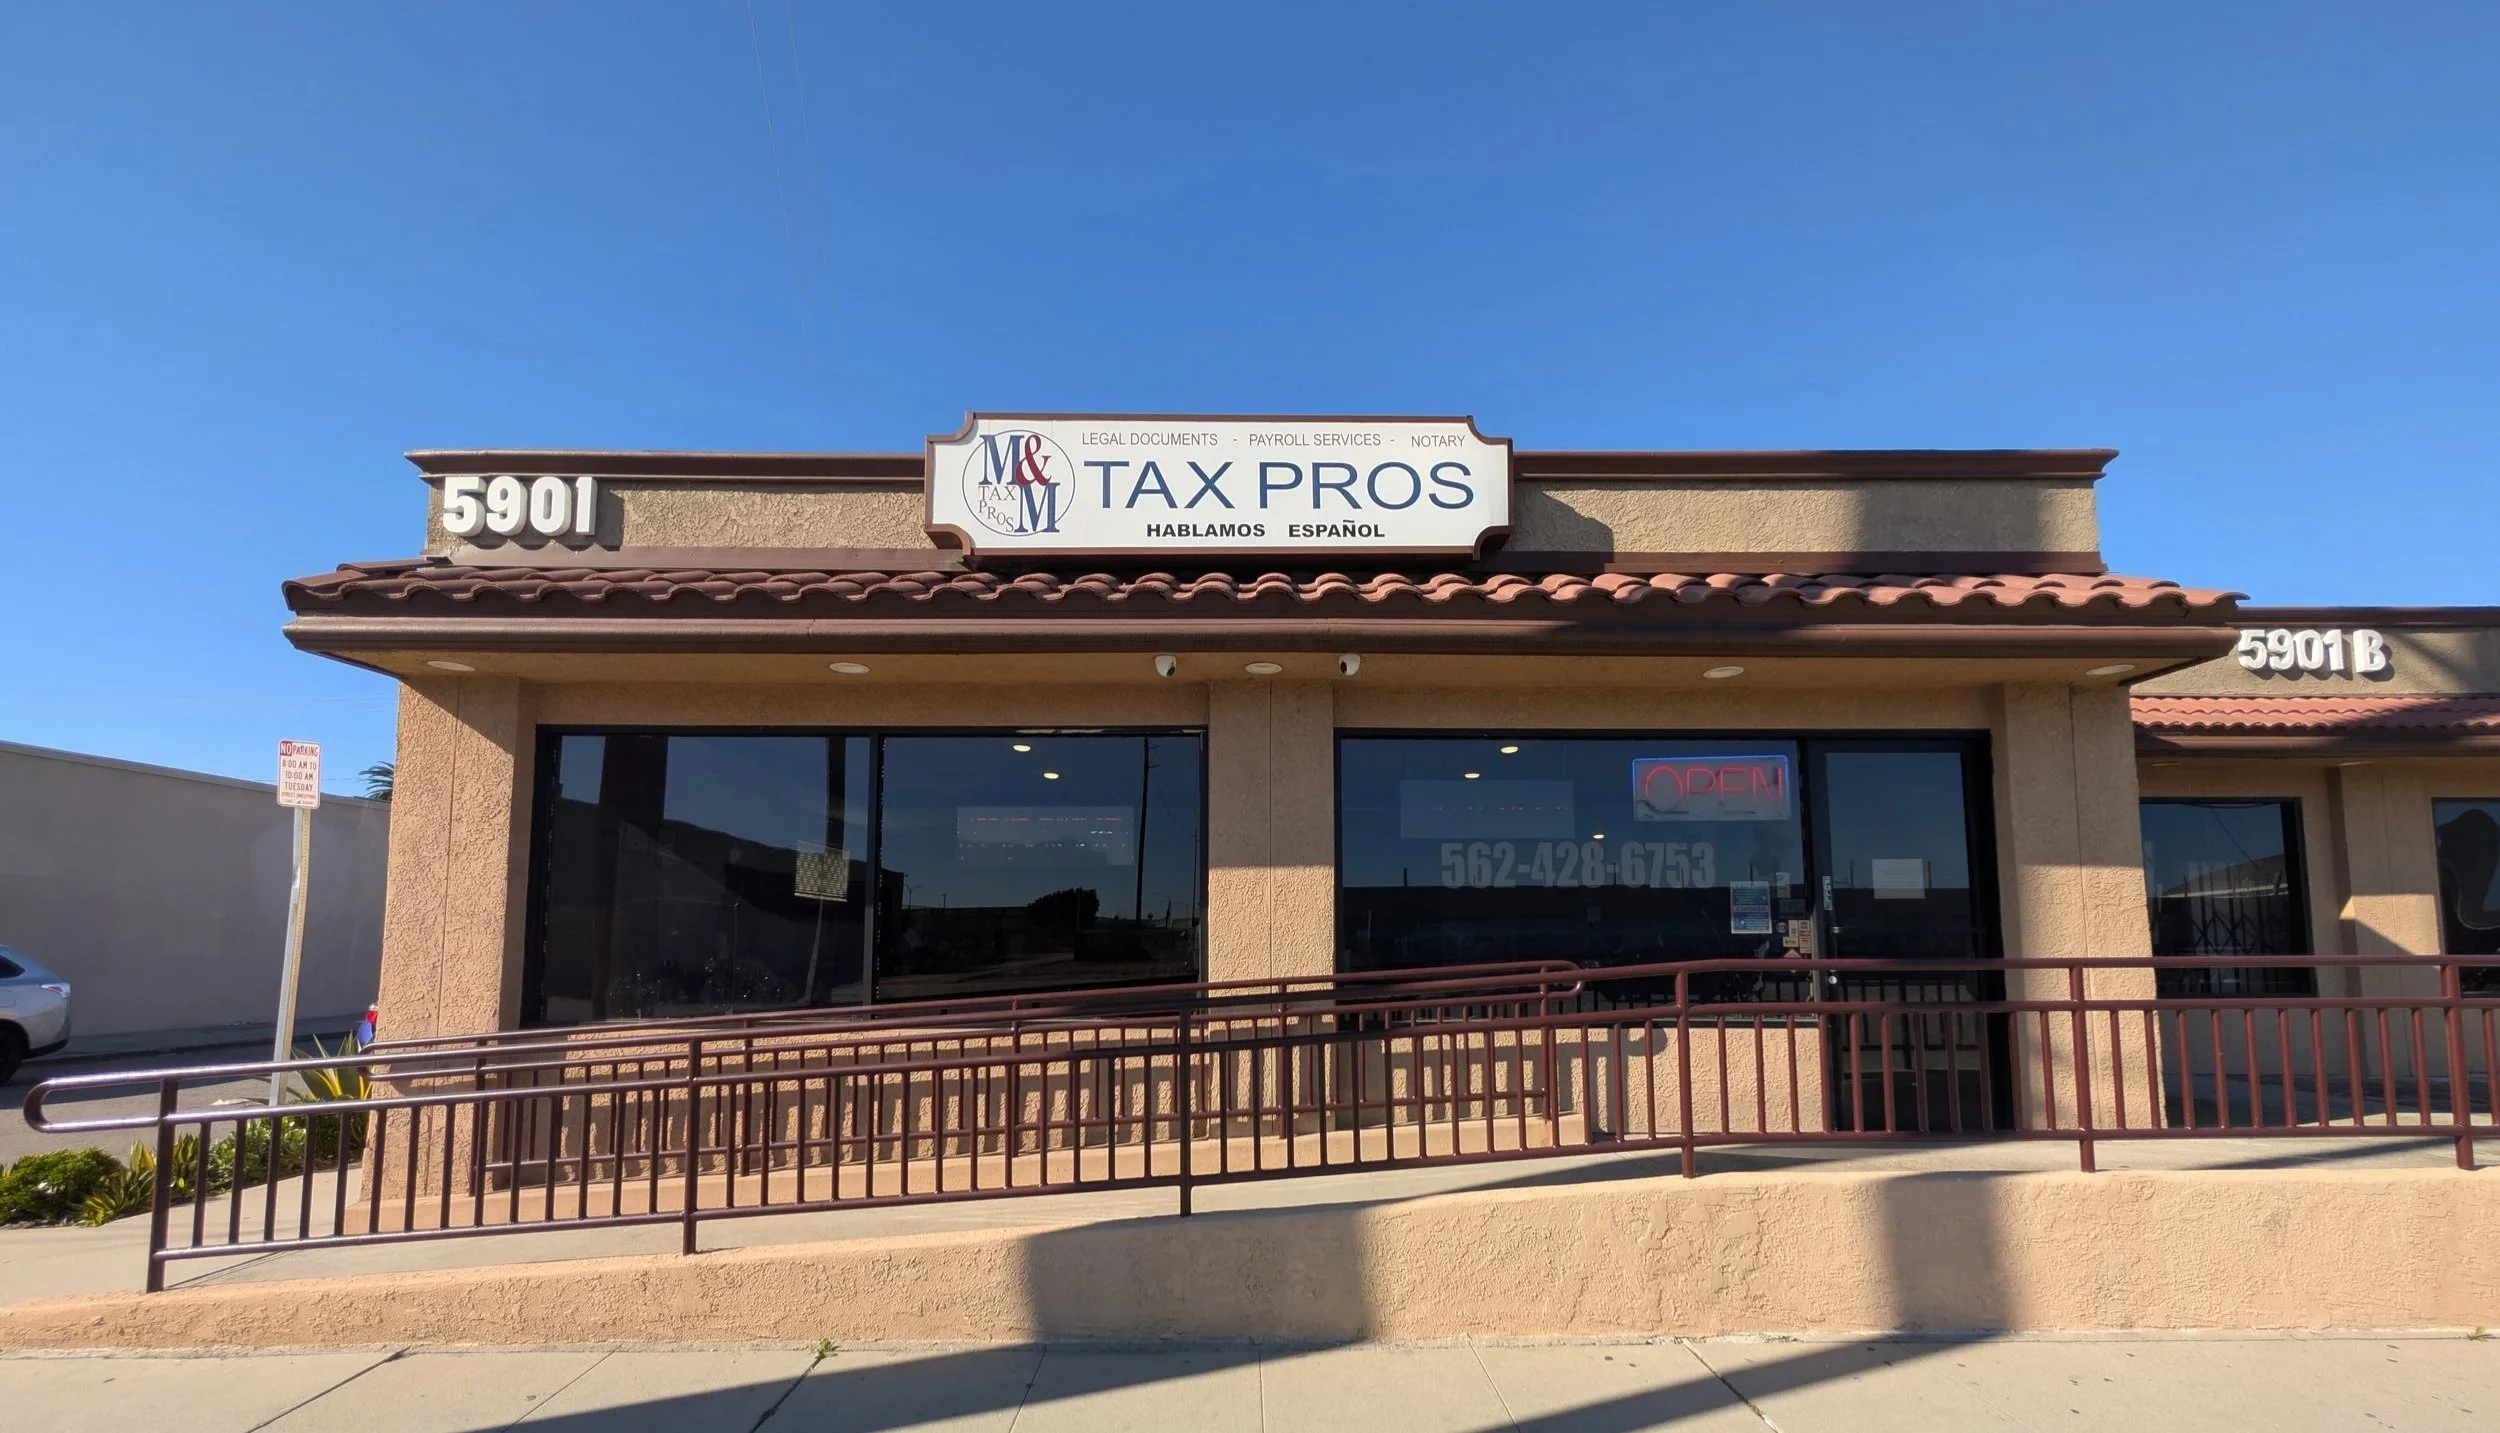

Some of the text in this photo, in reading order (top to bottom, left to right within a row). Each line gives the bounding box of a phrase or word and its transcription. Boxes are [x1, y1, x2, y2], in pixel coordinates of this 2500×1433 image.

[1081, 432, 1126, 446] LEGAL
[1130, 432, 1218, 446] DOCUMENTS
[1249, 433, 1309, 446] PAYROLL
[1313, 433, 1381, 446] SERVICES
[1411, 435, 1466, 447] NOTARY
[977, 485, 1017, 501] TAX
[1083, 460, 1474, 510] TAX PROS
[442, 475, 598, 537] 5901
[977, 500, 1014, 533] PROS
[1146, 519, 1386, 538] HABLAMOS ESPAÑOL
[2237, 628, 2387, 673] 5901 B
[281, 742, 319, 757] NO PARKING
[298, 761, 308, 770] AM
[285, 782, 314, 791] TUESDAY
[304, 773, 314, 781] AM
[1642, 765, 1784, 813] OPEN
[1440, 841, 1716, 889] 562-428-6753
